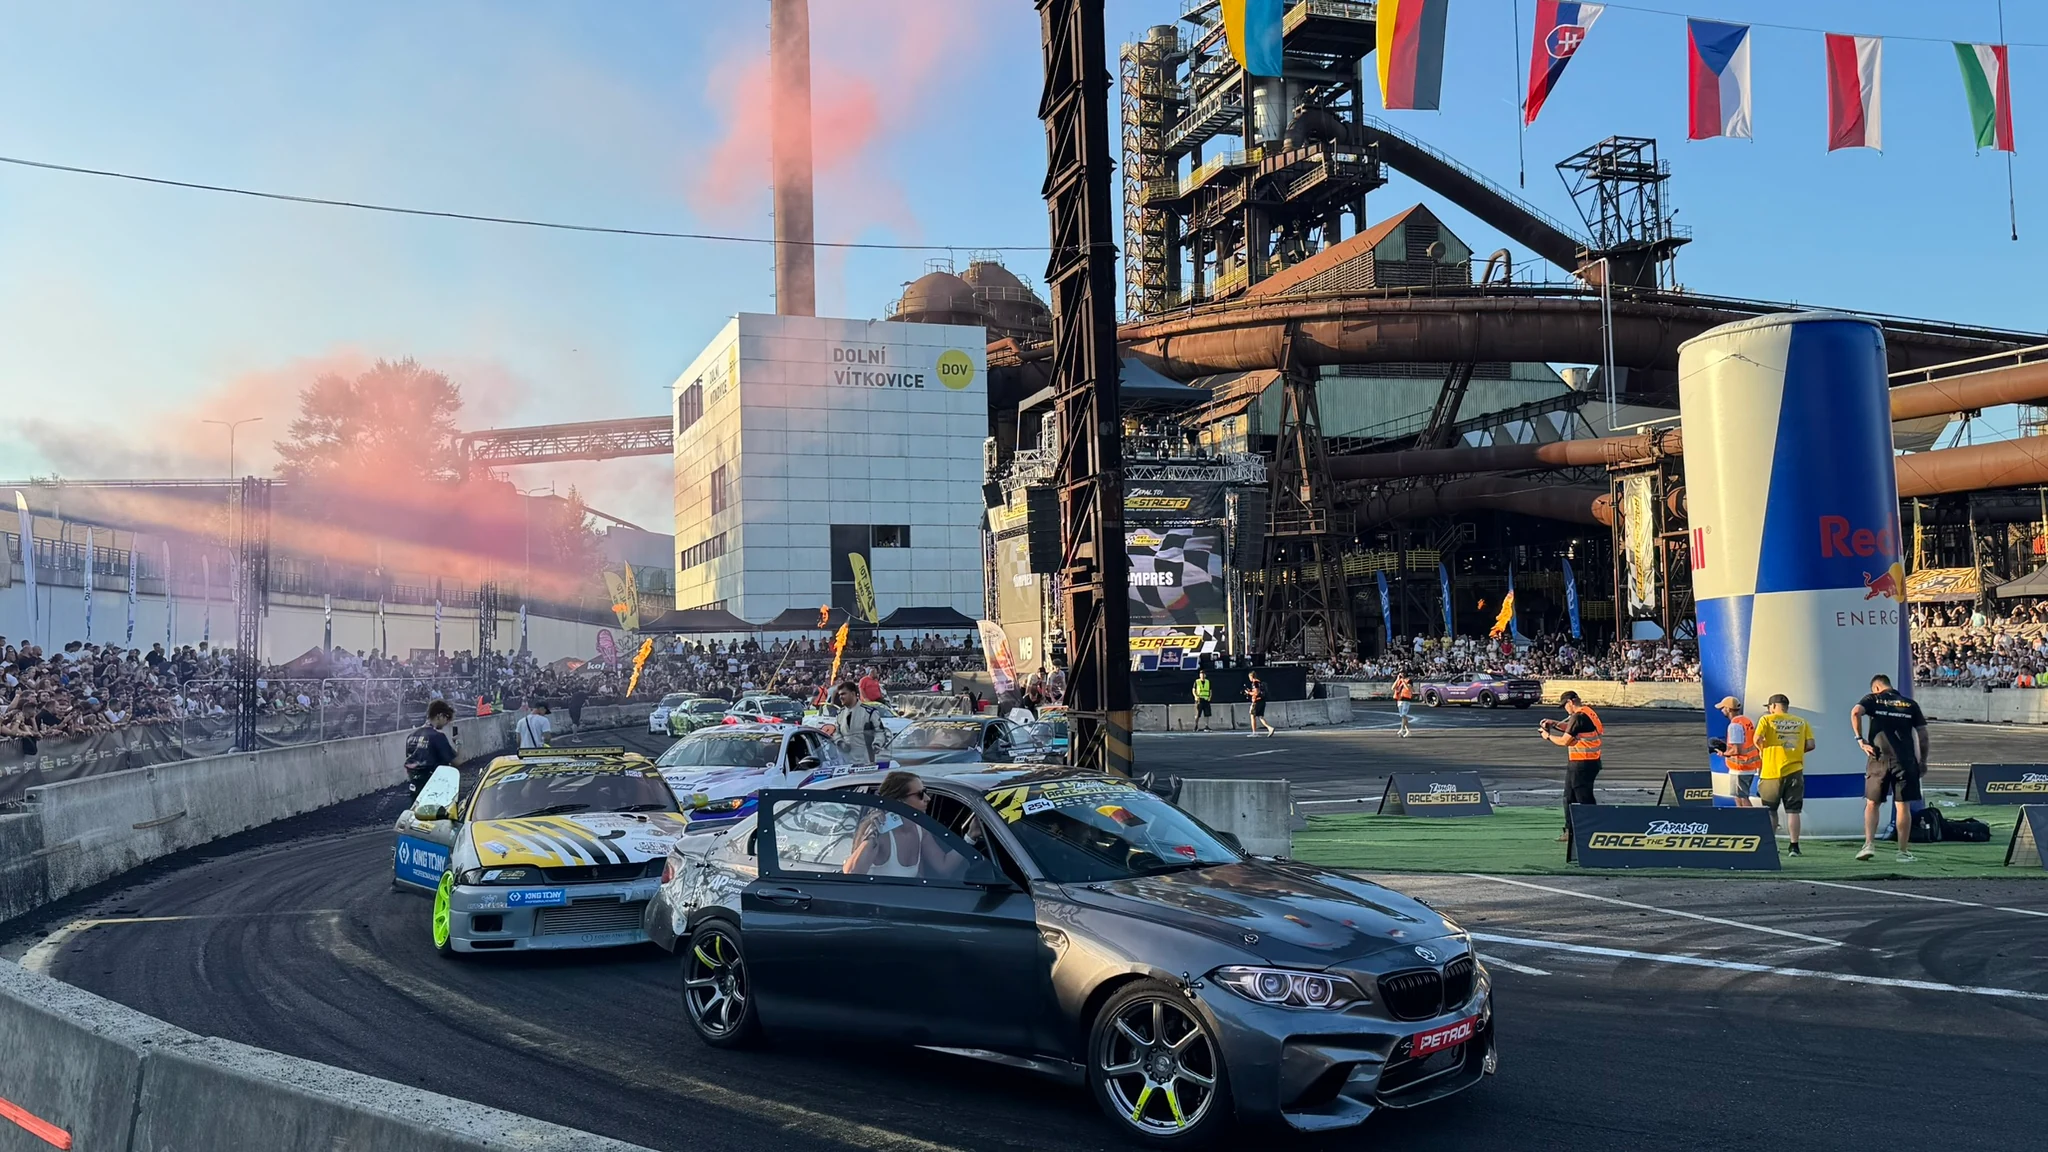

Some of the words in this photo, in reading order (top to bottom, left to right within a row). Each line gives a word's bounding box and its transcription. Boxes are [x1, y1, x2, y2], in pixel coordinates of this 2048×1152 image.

[833, 346, 886, 364] DOLNÍ
[941, 363, 968, 375] DOV
[834, 367, 924, 388] VÍTKOVICE
[1139, 498, 1188, 507] STREETS
[1818, 512, 1897, 558] Red
[1137, 637, 1199, 648] STREETS
[1988, 783, 2022, 791] RACE
[1408, 793, 1432, 803] RACE
[1440, 793, 1479, 803] STREETS
[1026, 802, 1051, 812] 254
[1647, 820, 1690, 836] ZAPAL
[1689, 822, 1709, 835] TO!
[1592, 834, 1646, 848] RACE
[1663, 835, 1758, 850] STREETS
[412, 847, 428, 868] KING
[427, 852, 447, 873] TONY
[525, 892, 542, 900] KING
[542, 891, 562, 899] TONY
[1420, 1022, 1472, 1050] PETROL
